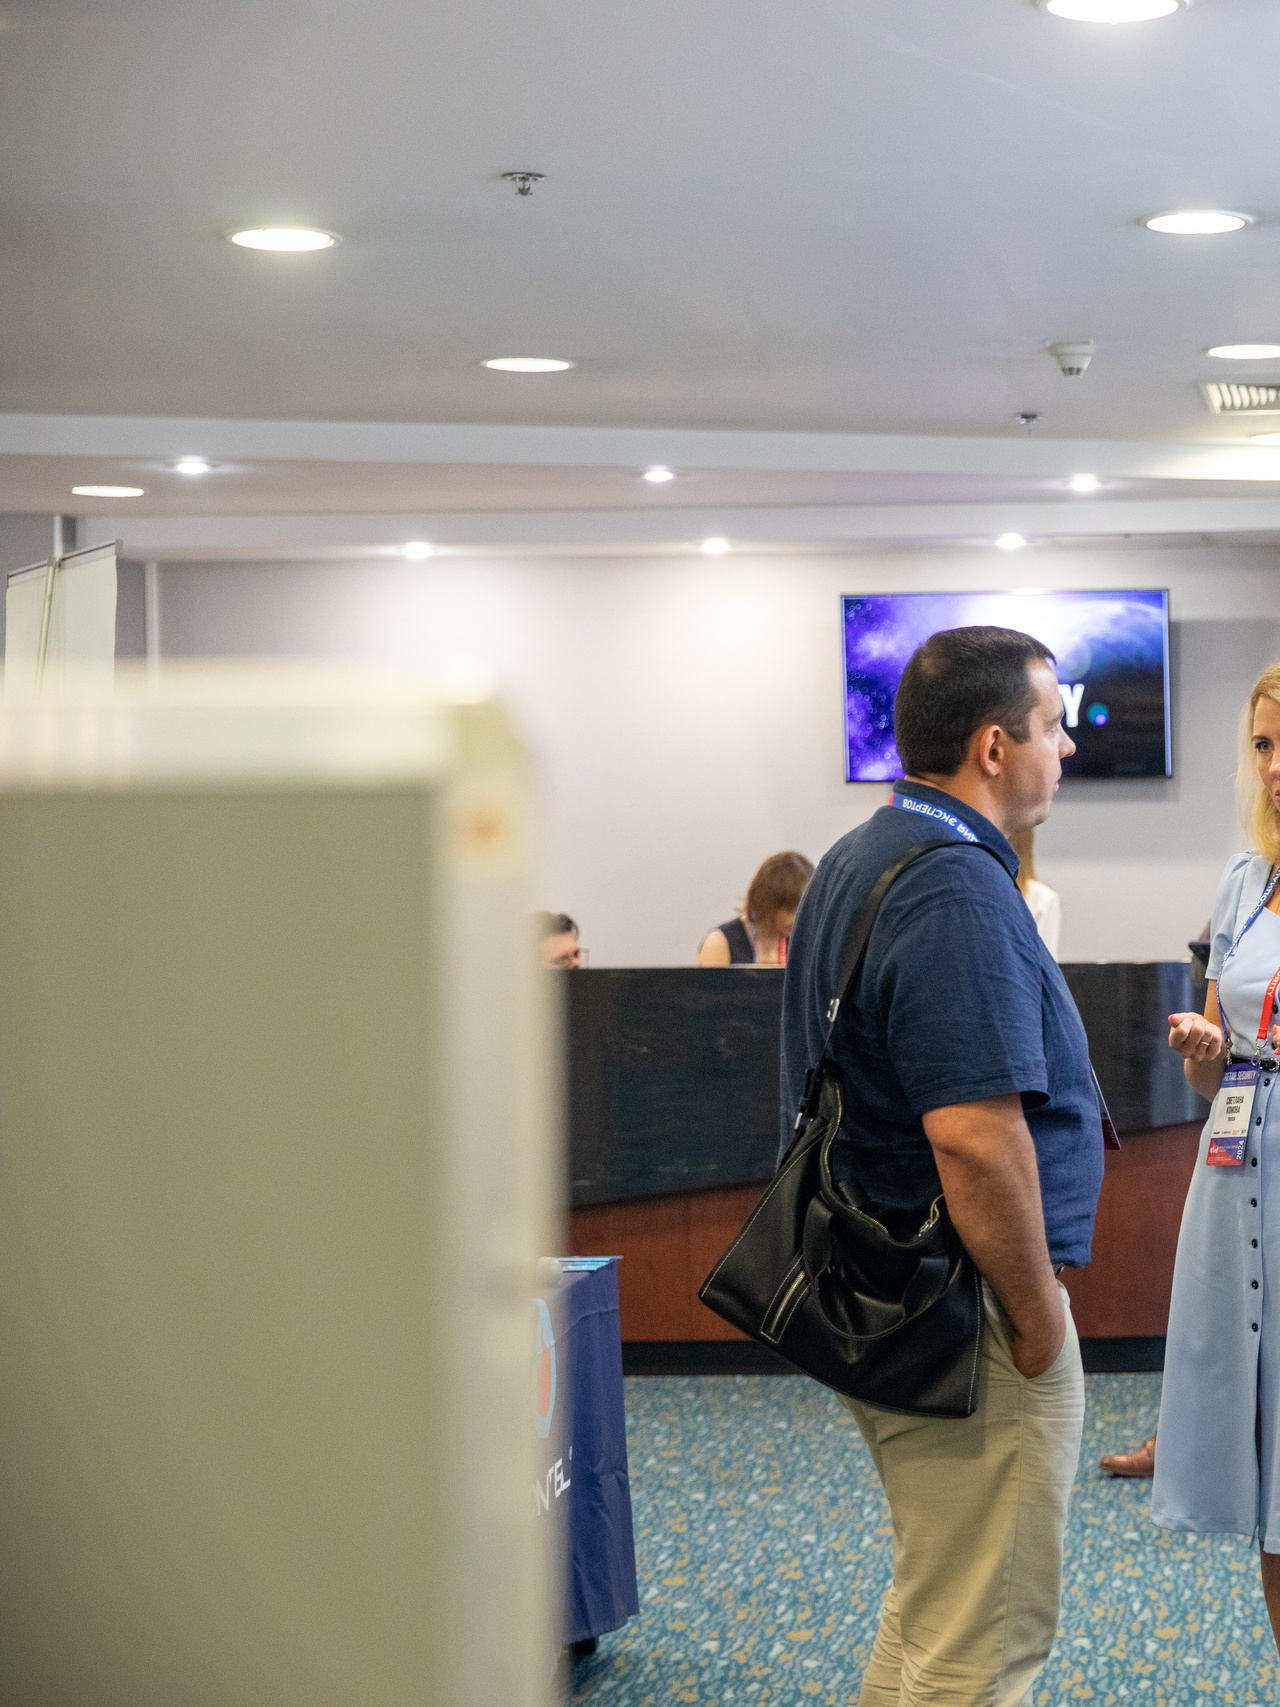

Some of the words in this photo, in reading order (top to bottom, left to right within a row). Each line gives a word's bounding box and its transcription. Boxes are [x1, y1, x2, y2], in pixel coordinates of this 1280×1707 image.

[1060, 683, 1085, 728] Y
[902, 798, 958, 827] ЭКСПЕРТОВ
[1236, 1140, 1245, 1160] 2024
